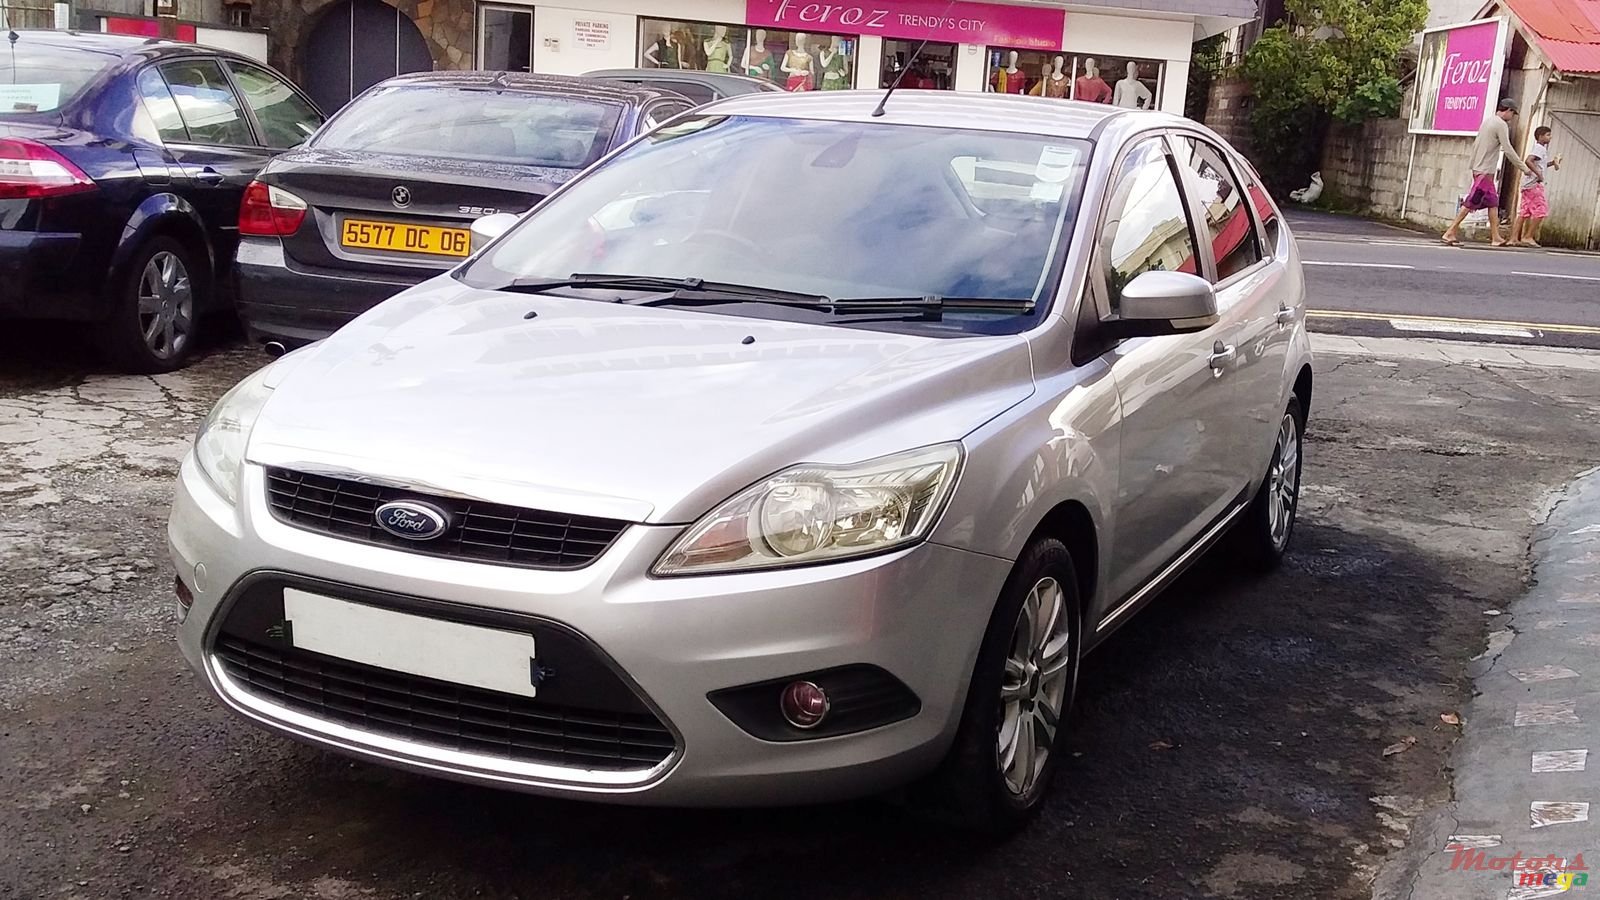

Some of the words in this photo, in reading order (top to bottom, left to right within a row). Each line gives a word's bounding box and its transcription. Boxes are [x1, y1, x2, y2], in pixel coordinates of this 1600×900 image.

[769, 0, 889, 28] Feroz
[898, 14, 955, 29] TRENDY'S
[958, 19, 985, 31] CITY
[1442, 53, 1491, 88] Feroz
[1445, 96, 1467, 110] TRENDY'S
[1467, 96, 1479, 110] CITY
[346, 223, 396, 246] 5577
[405, 228, 430, 249] DC
[440, 231, 466, 252] 06
[388, 508, 426, 531] Ford
